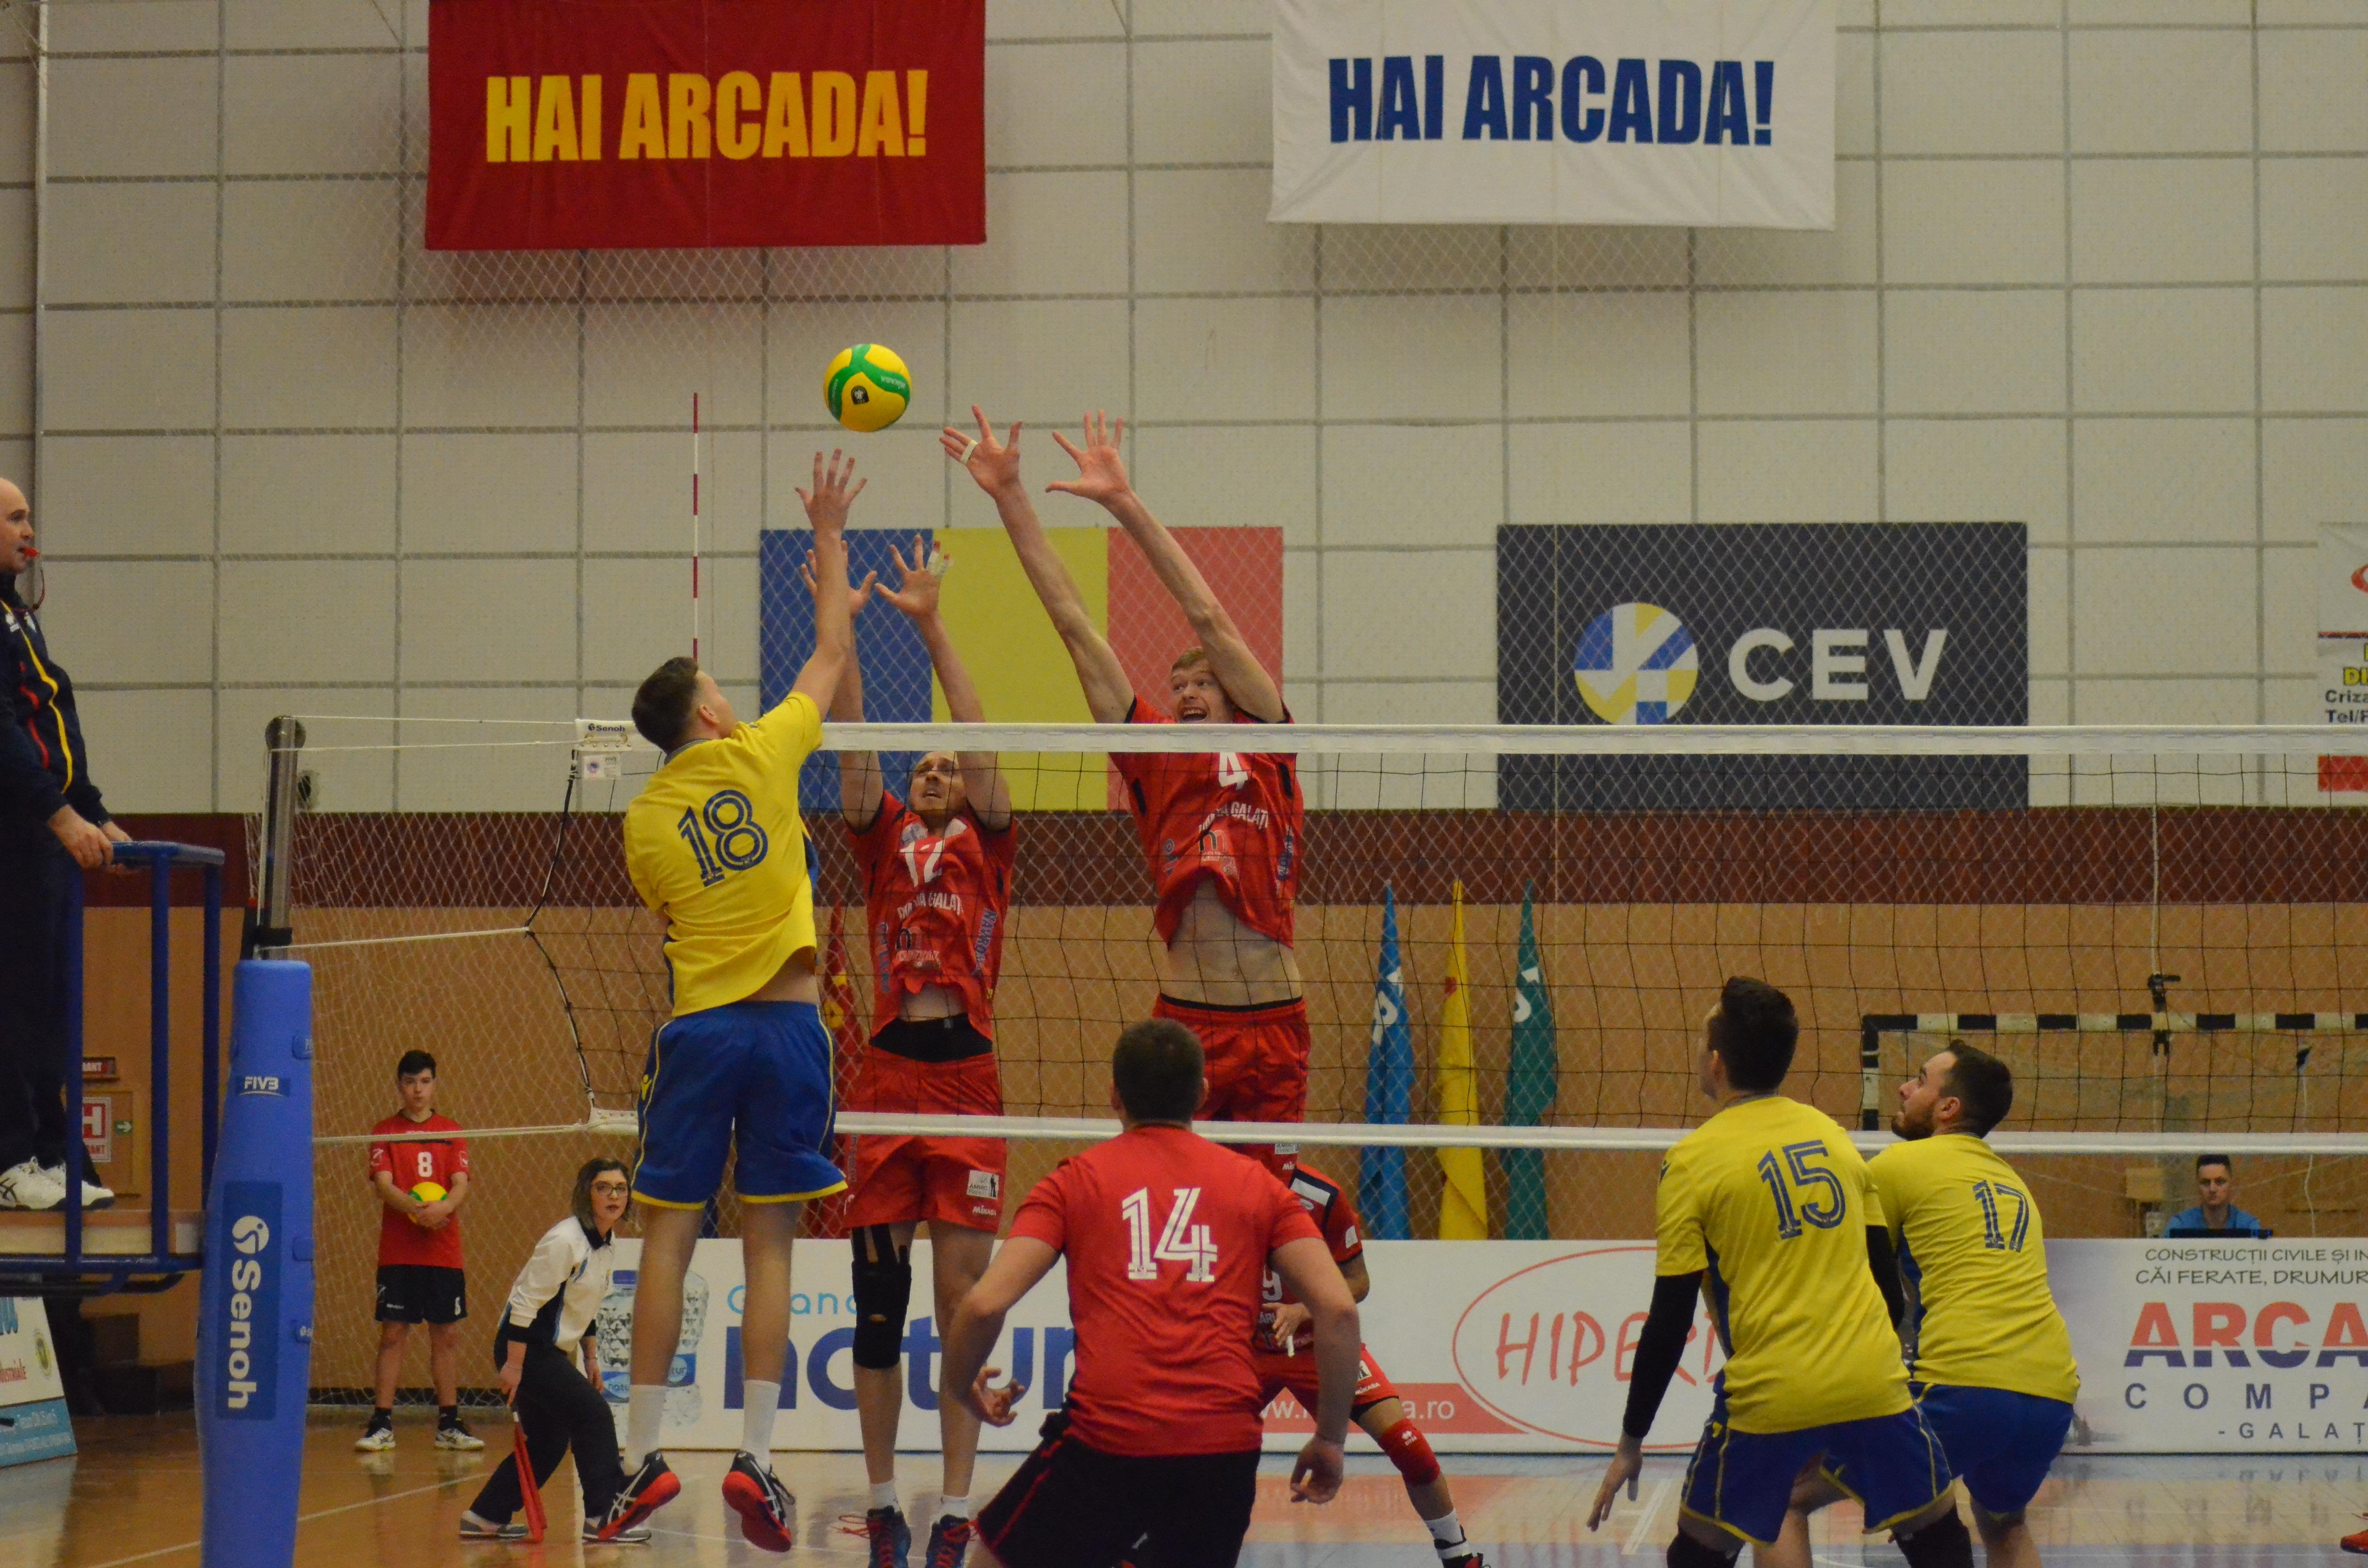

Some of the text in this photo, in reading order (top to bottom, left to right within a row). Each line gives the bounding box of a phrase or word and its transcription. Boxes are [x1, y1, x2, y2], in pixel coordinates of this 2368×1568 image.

[486, 70, 929, 162] HAI ARCADA!
[1329, 55, 1775, 146] HAI ARCADA!
[1730, 627, 1948, 702] CEV
[678, 789, 768, 887] 18
[244, 1076, 279, 1090] FIVB
[418, 1152, 432, 1177] 8
[1757, 1139, 1846, 1239] 15
[1122, 1187, 1218, 1282] 14
[1972, 1180, 2030, 1253] 17
[2136, 1266, 2171, 1284] CĂI
[2178, 1270, 2267, 1286] FERATE,
[2272, 1249, 2327, 1261] CIVILE
[228, 1259, 261, 1409] Senoh
[2124, 1301, 2368, 1368] ARCA
